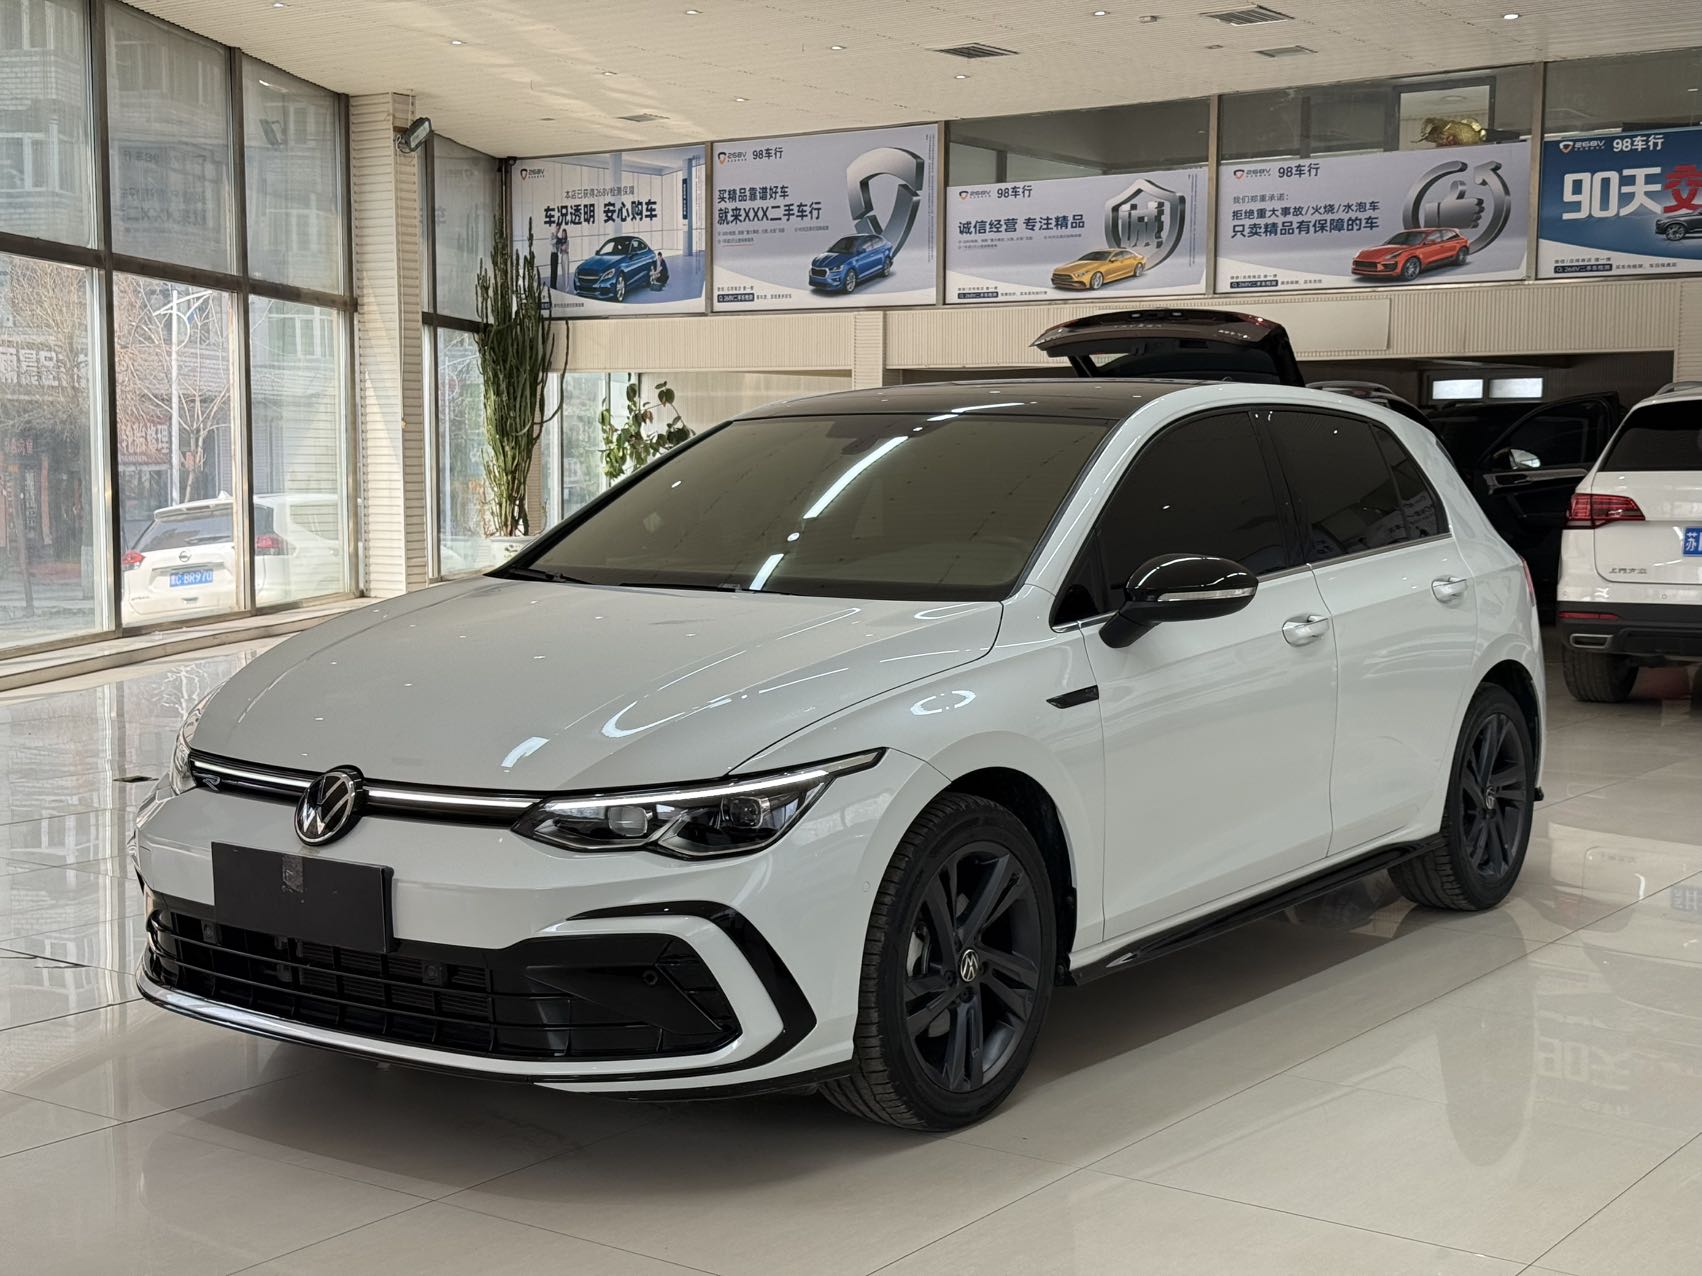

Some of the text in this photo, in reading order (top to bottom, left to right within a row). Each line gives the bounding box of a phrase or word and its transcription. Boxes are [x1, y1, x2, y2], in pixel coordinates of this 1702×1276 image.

[752, 146, 784, 160] 98车行
[1613, 135, 1664, 152] 98车行
[1278, 162, 1320, 179] 98车行
[565, 185, 635, 200] 本店已获得268V检测保障
[717, 185, 789, 204] 买精品靠谱好车
[996, 185, 1033, 199] 98车行
[544, 203, 595, 227] 车况透明
[603, 199, 658, 223] 安心购车
[717, 201, 822, 226] 就来XXX二手车行
[1231, 200, 1380, 221] 拒绝重大事故/火烧/水泡车
[958, 213, 1085, 236] 诚信经营 专注精品
[1231, 215, 1379, 239] 只卖精品有保障的车
